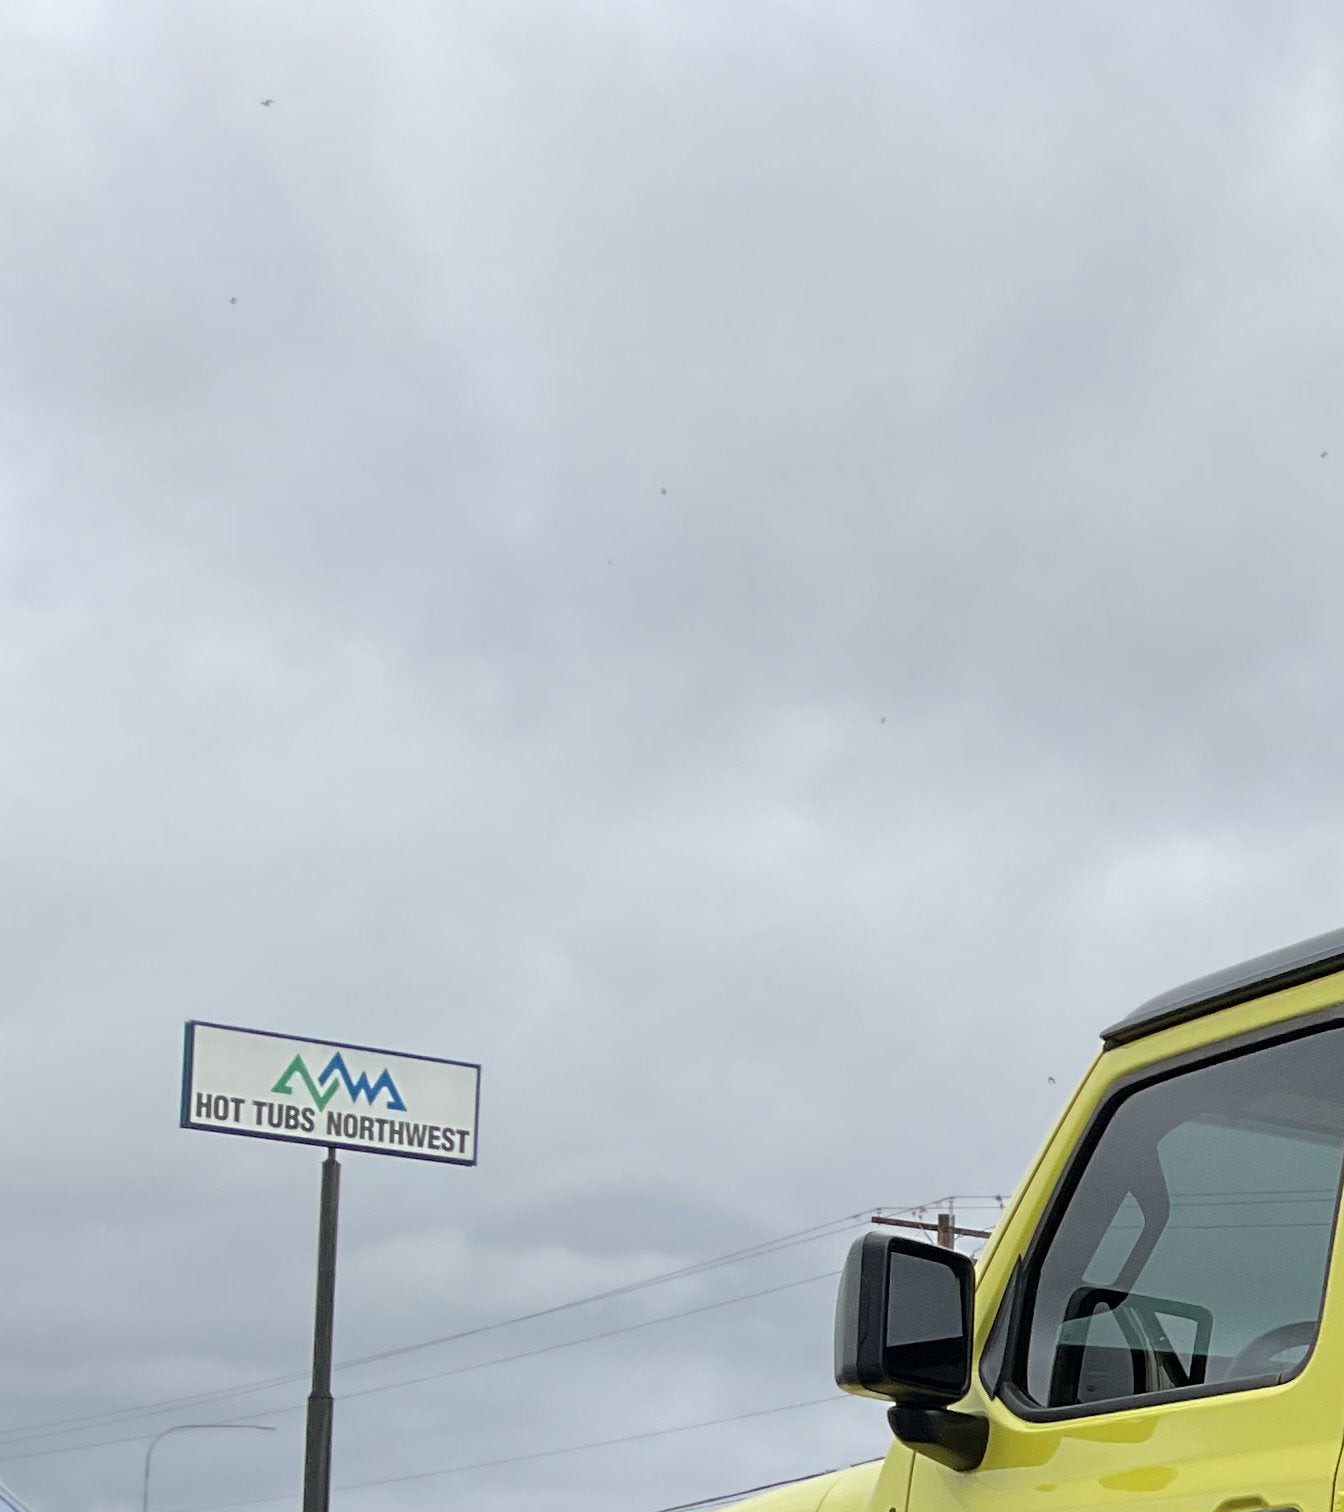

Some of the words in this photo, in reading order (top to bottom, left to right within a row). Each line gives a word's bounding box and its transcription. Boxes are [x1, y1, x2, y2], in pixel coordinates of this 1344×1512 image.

[195, 1092, 246, 1123] HOT
[251, 1100, 316, 1133] TUBS
[325, 1110, 471, 1154] NORTHWEST
